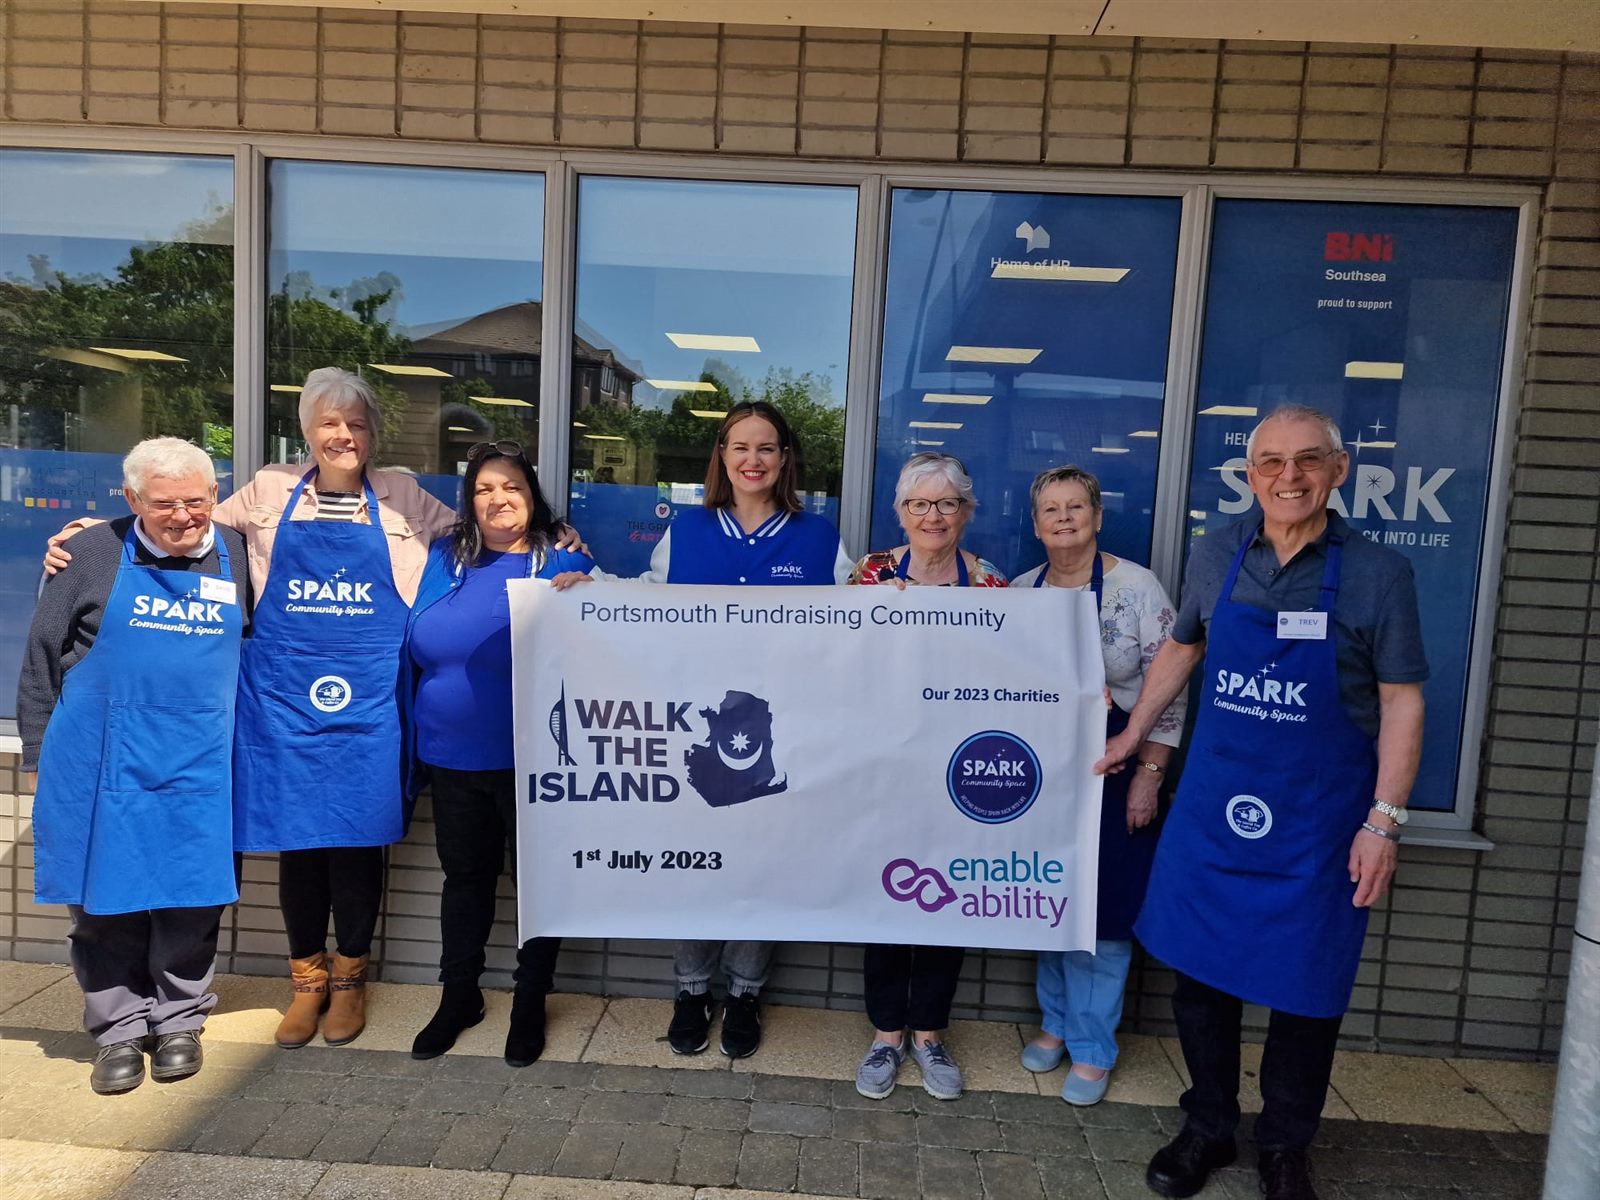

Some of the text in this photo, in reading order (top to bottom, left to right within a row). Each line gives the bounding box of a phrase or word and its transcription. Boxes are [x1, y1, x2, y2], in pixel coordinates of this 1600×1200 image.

[991, 257, 1071, 272] Home of HR
[1325, 269, 1387, 282] Southsea
[1317, 298, 1393, 310] proud to support
[1225, 432, 1248, 445] HEL
[1218, 457, 1456, 523] SRK
[1384, 531, 1417, 546] INTO
[1420, 533, 1450, 547] LIFE
[771, 565, 803, 574] SPARK
[287, 579, 373, 602] SPARK
[133, 594, 224, 622] SPARK
[286, 603, 375, 616] Community Space
[580, 602, 1006, 632] Portsmouth Fundraising Community
[129, 617, 225, 636] Community Space
[1298, 618, 1319, 626] TREV
[922, 688, 1060, 703] Our 2023 Charities
[1216, 669, 1308, 707] SPARK
[574, 699, 693, 732] WALK
[1213, 696, 1308, 723] Community Space
[588, 735, 667, 767] THE
[963, 759, 1026, 776] SPARK
[529, 772, 680, 804] ISLAND
[961, 779, 1027, 789] Community Space
[572, 849, 723, 874] 1st July 2023
[949, 851, 1064, 884] enable
[961, 885, 1068, 928] ability
